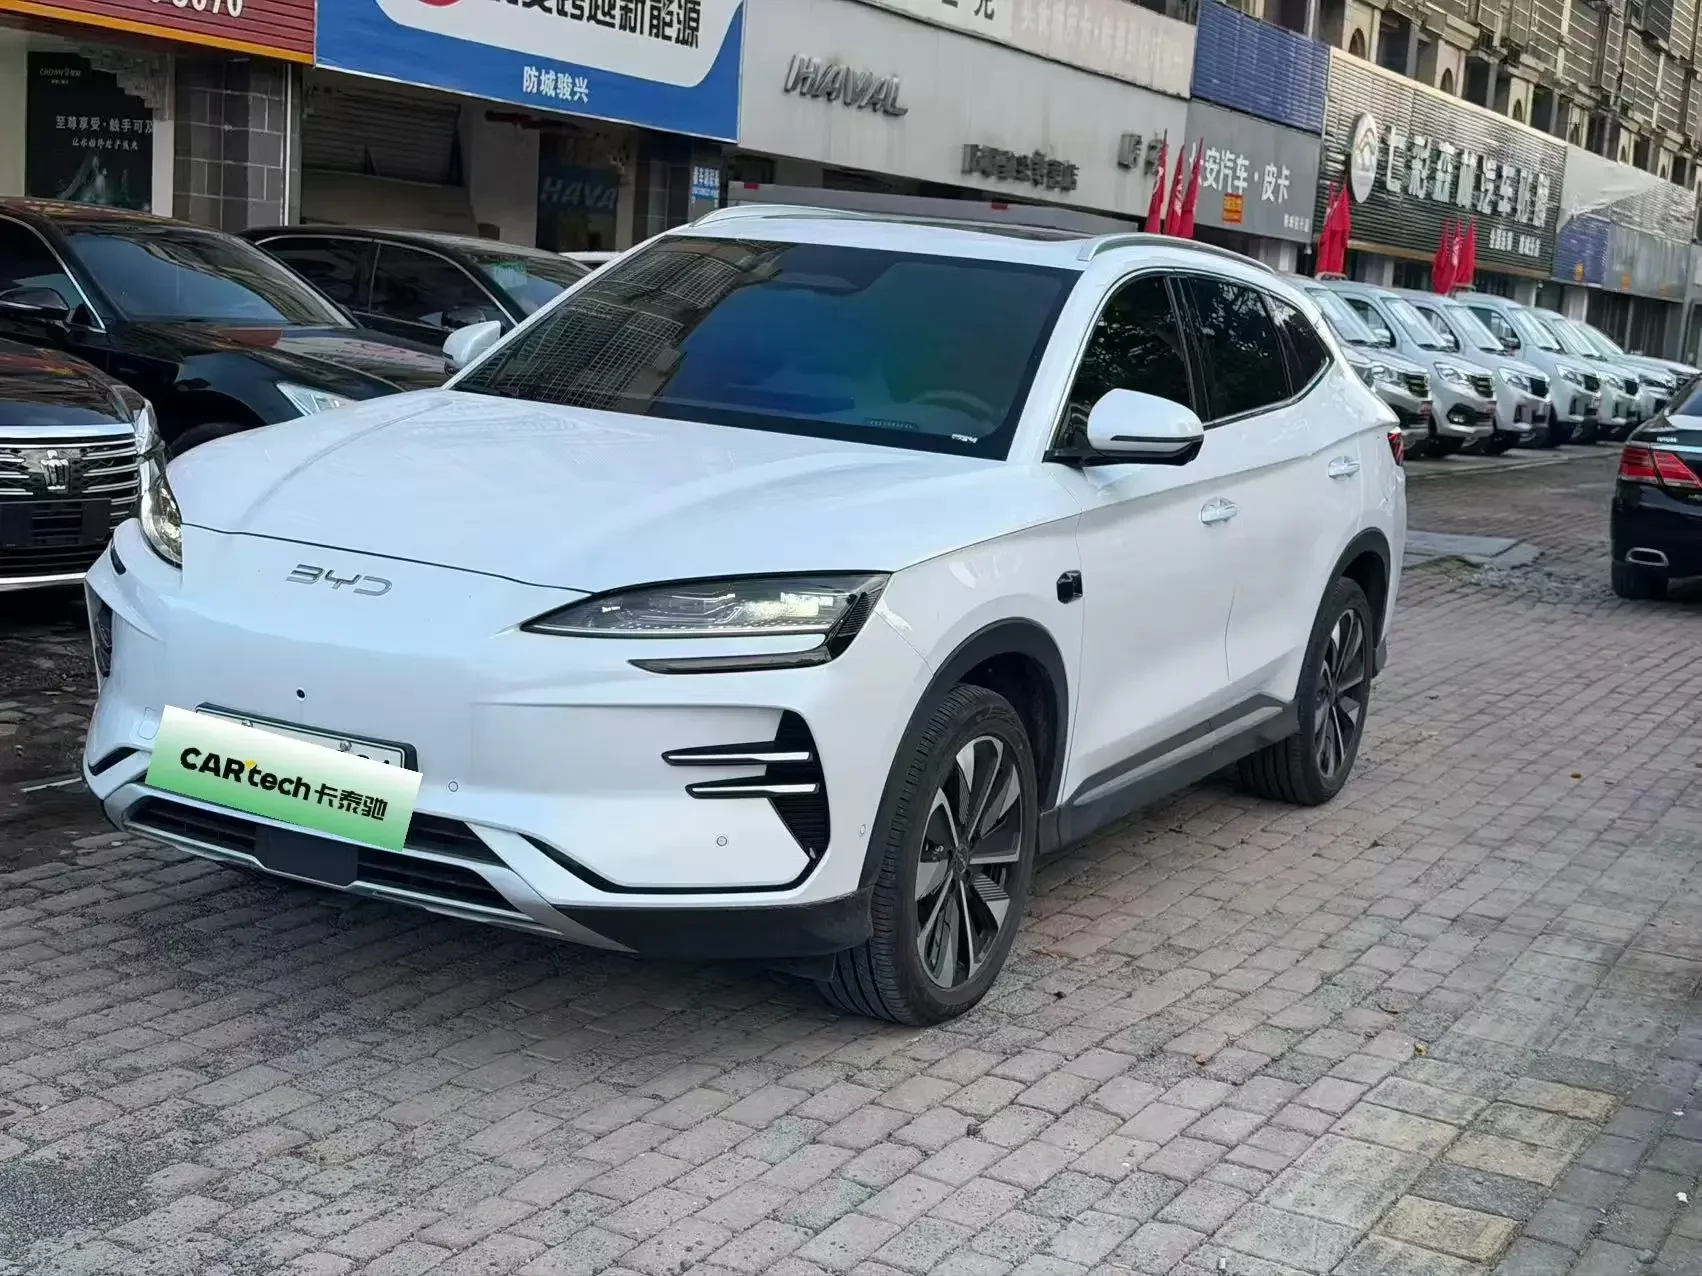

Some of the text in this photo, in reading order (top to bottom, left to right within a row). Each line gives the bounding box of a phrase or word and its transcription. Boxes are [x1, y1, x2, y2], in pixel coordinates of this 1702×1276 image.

[522, 65, 589, 103] 防城骏兴
[783, 53, 909, 117] HAVAL
[285, 563, 393, 597] BYD
